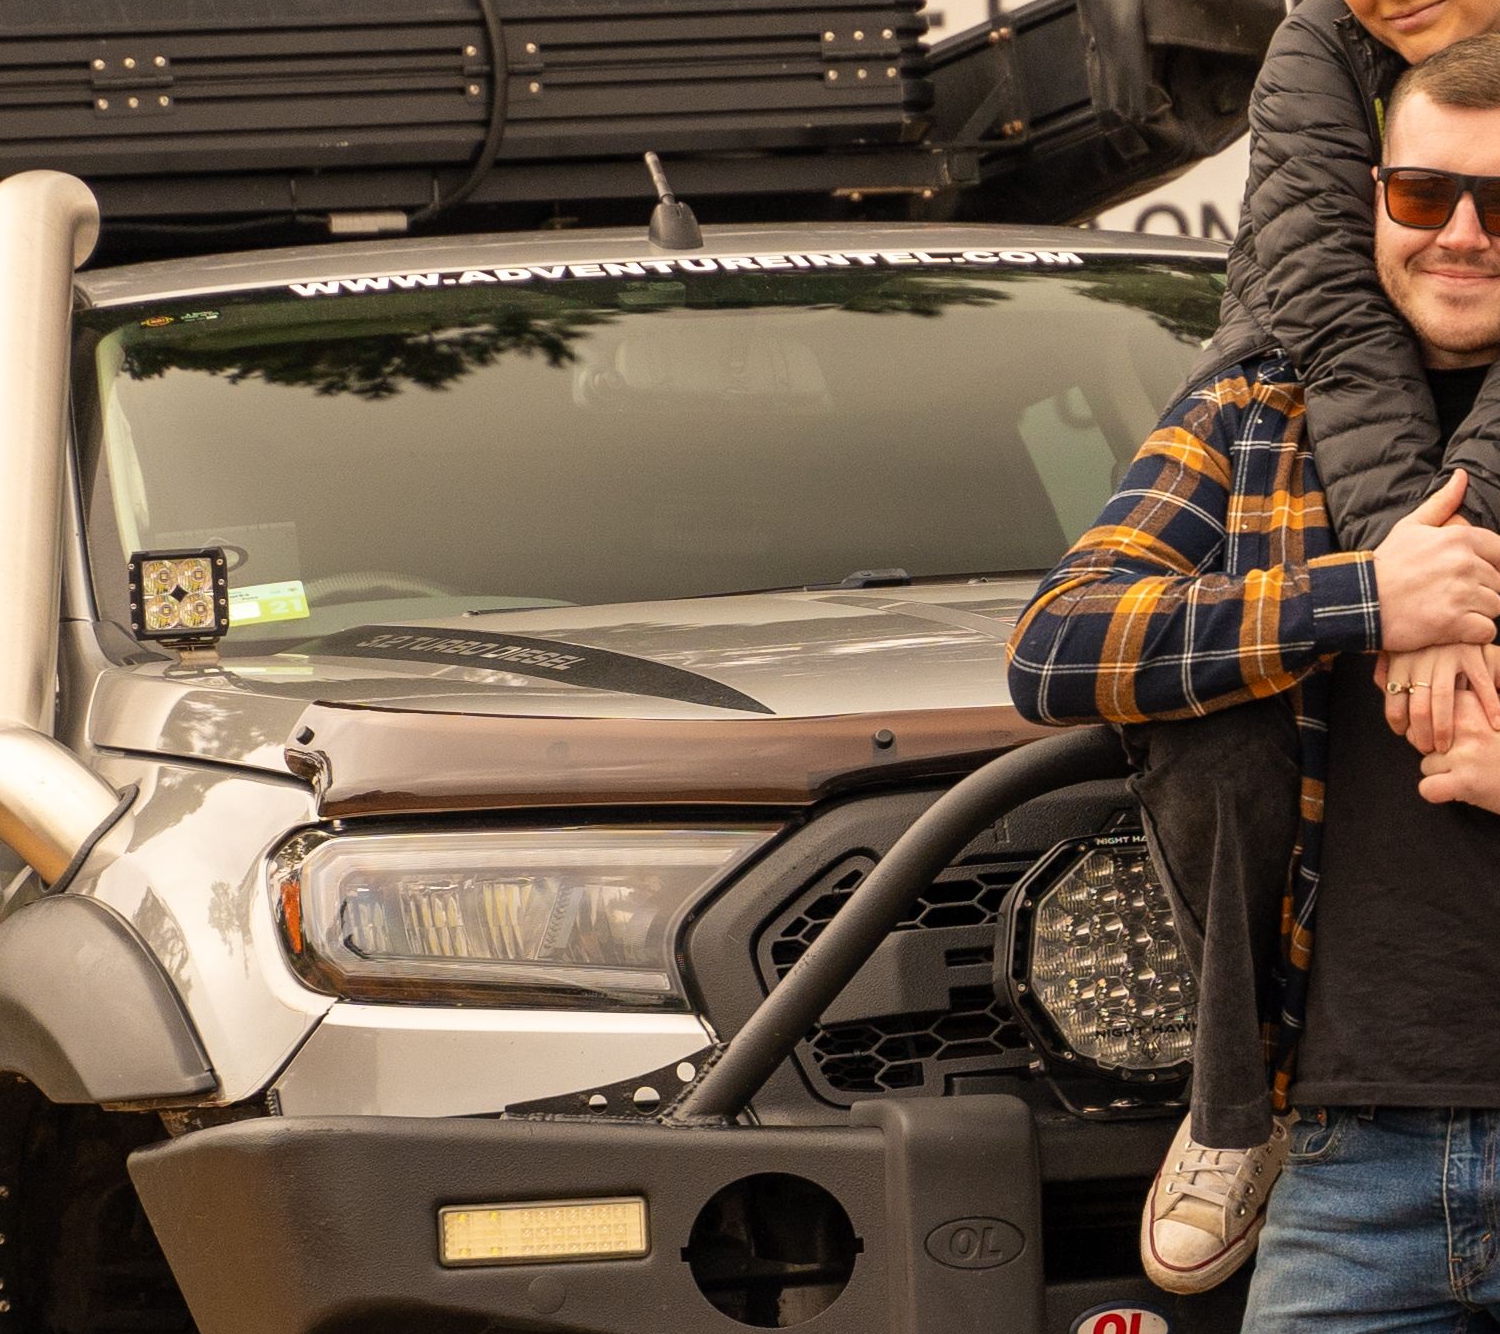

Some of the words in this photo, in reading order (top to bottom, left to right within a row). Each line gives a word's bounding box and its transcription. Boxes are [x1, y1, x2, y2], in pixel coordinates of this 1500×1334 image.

[288, 250, 1085, 298] WWW.ADVENTUREINTEL.COM
[398, 636, 499, 656] TURBO
[480, 646, 586, 670] DIESEL
[1095, 836, 1129, 845] NIGHT
[1132, 835, 1148, 843] HA
[1096, 1025, 1145, 1038] NIGHT
